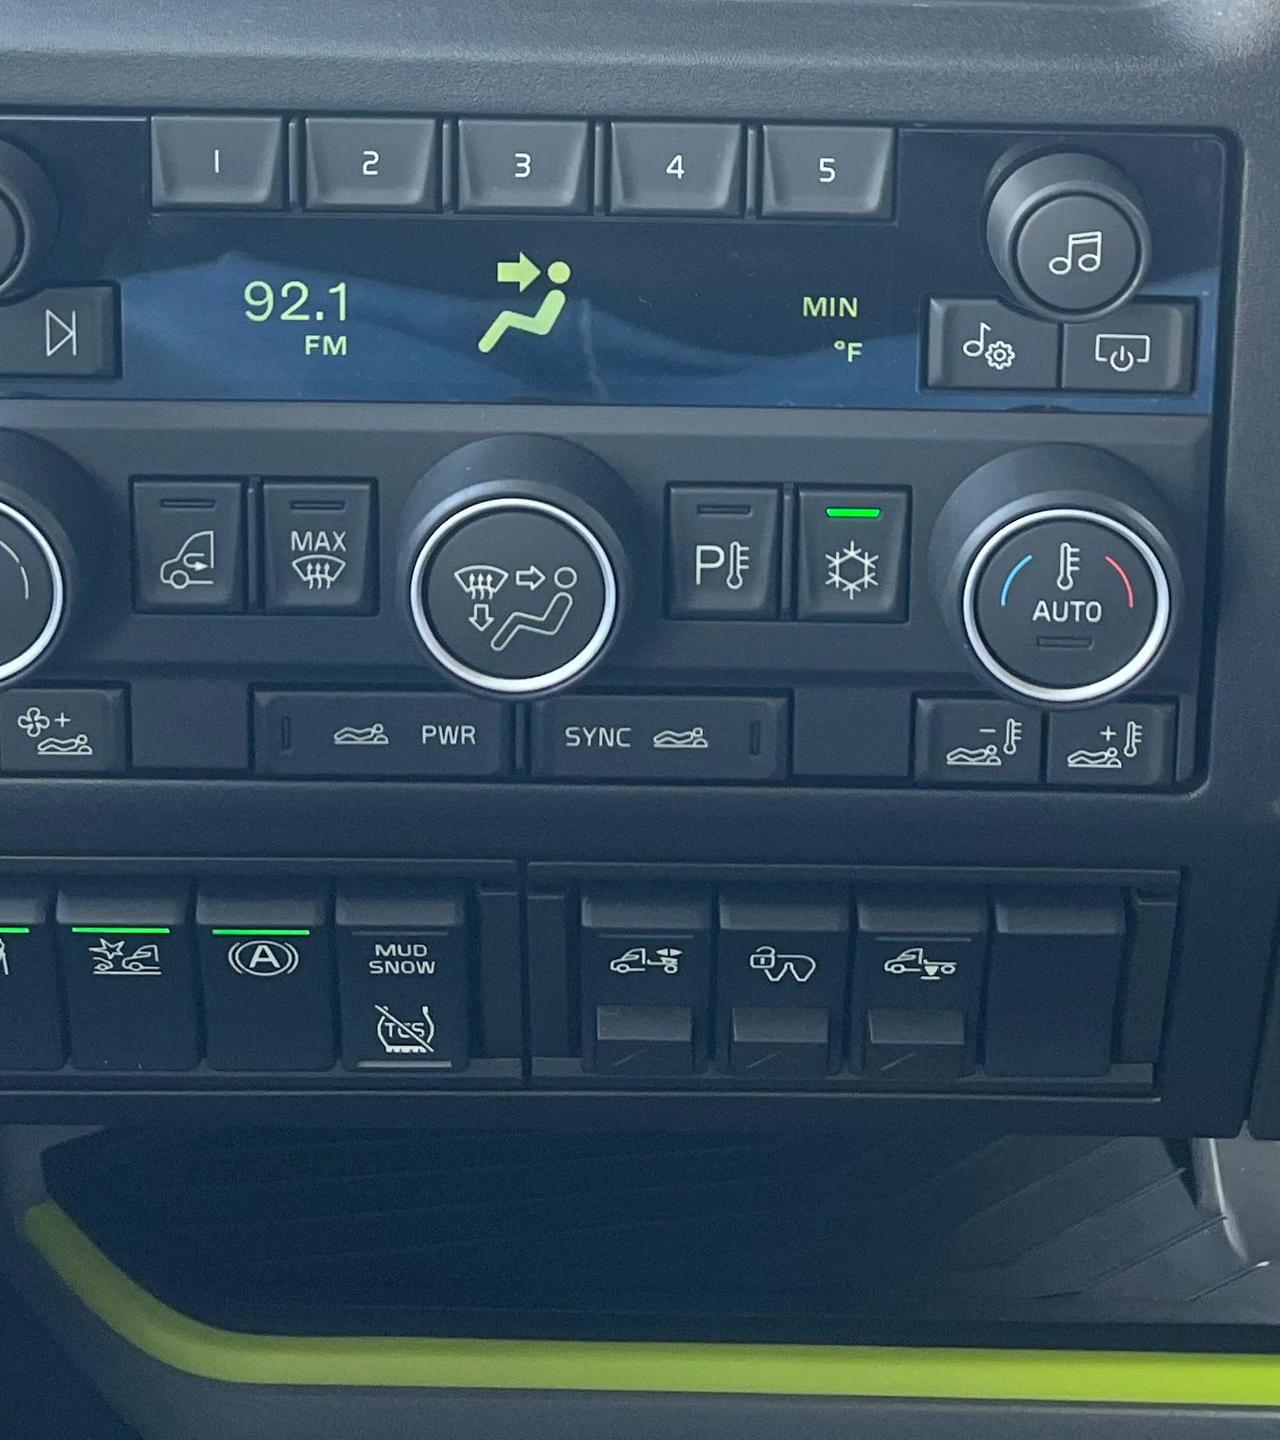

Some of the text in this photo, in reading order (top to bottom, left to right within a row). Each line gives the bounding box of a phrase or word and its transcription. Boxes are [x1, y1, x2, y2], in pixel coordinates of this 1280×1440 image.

[214, 149, 220, 174] 1
[362, 150, 380, 176] 2
[514, 152, 531, 178] 3
[665, 154, 685, 180] 4
[819, 157, 836, 183] 5
[244, 280, 346, 322] 92.1
[803, 296, 858, 318] MIN
[305, 334, 347, 356] FM
[291, 530, 347, 552] MAX
[1032, 600, 1102, 623] AUTO
[422, 725, 476, 745] PWR
[565, 726, 631, 748] SYNC
[249, 943, 280, 969] A
[375, 943, 428, 957] MUD
[368, 960, 436, 975] SNOW
